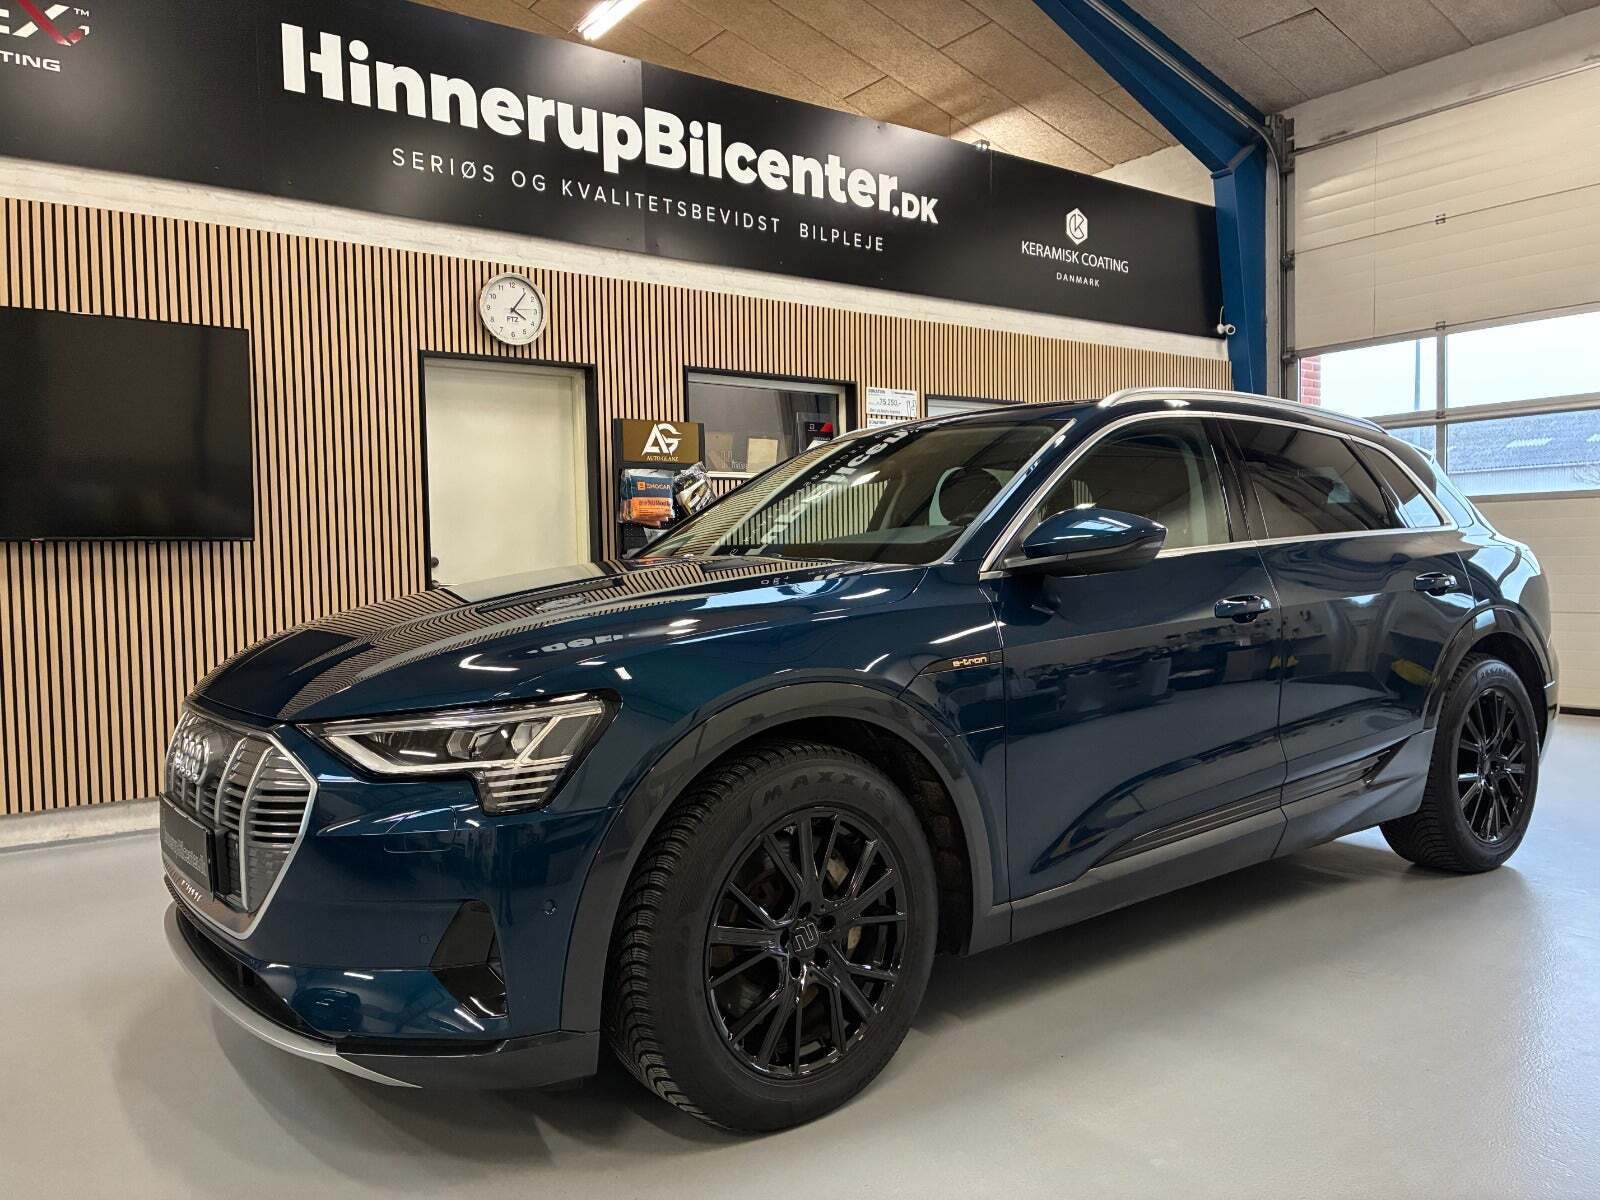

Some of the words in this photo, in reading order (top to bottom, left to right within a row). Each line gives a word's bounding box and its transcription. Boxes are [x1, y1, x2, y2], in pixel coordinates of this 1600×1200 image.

[281, 22, 939, 225] HinnerupBilcenter.DK
[392, 147, 495, 183] SERIØS
[511, 170, 547, 191] OG
[561, 178, 781, 234] KVALITETSBEVIDST
[799, 222, 885, 252] BILPLEJE
[1021, 240, 1080, 264] KERAMISK
[1081, 252, 1129, 274] COATING
[1056, 271, 1100, 288] DANMARK
[506, 315, 519, 323] FTZ
[952, 656, 988, 667] e-tron
